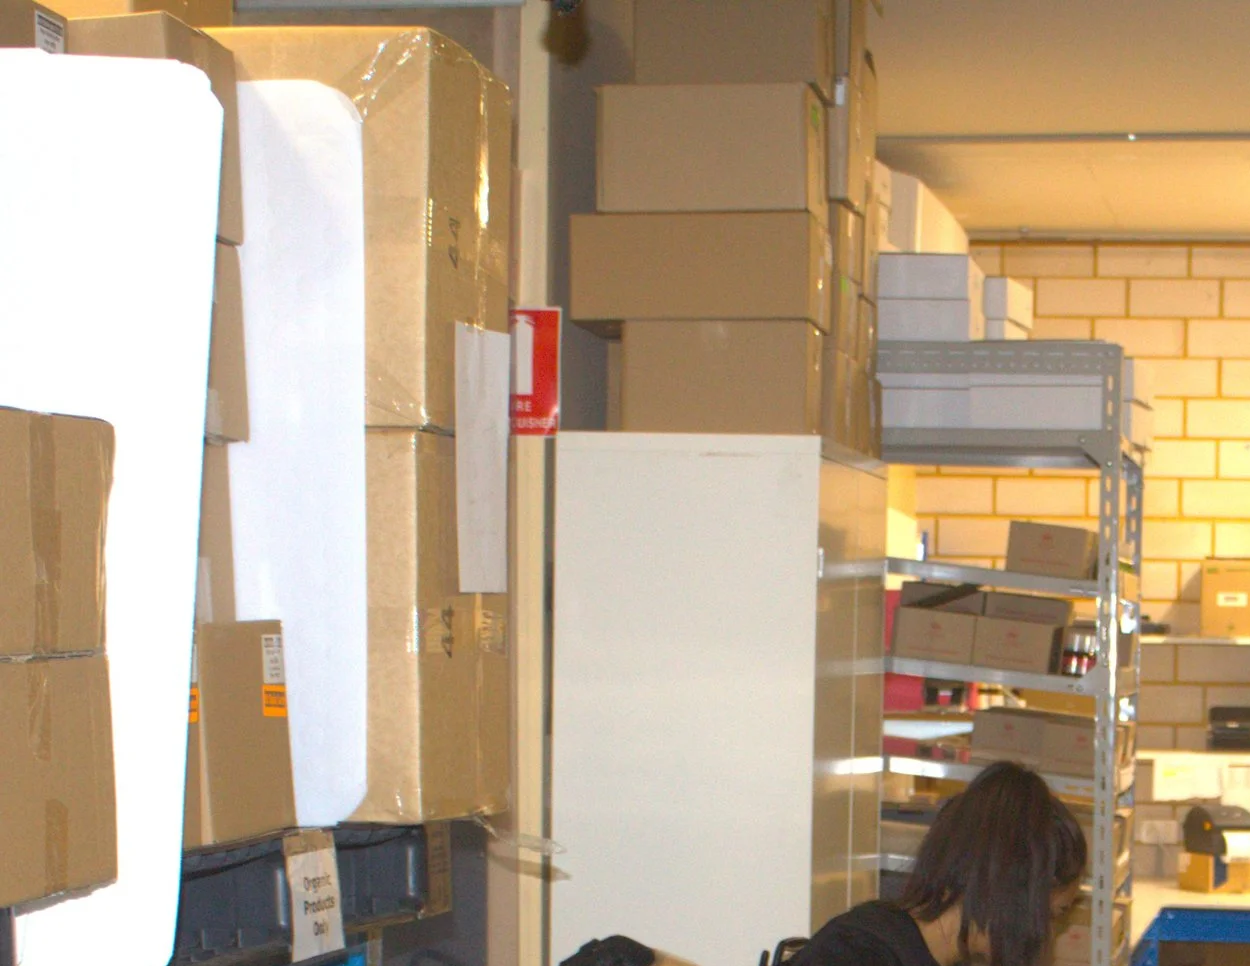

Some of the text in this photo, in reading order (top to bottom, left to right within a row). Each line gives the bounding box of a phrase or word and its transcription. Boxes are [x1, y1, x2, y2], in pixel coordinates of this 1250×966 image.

[303, 873, 332, 893] Organic
[303, 896, 336, 916] Products
[313, 919, 330, 937] Only
